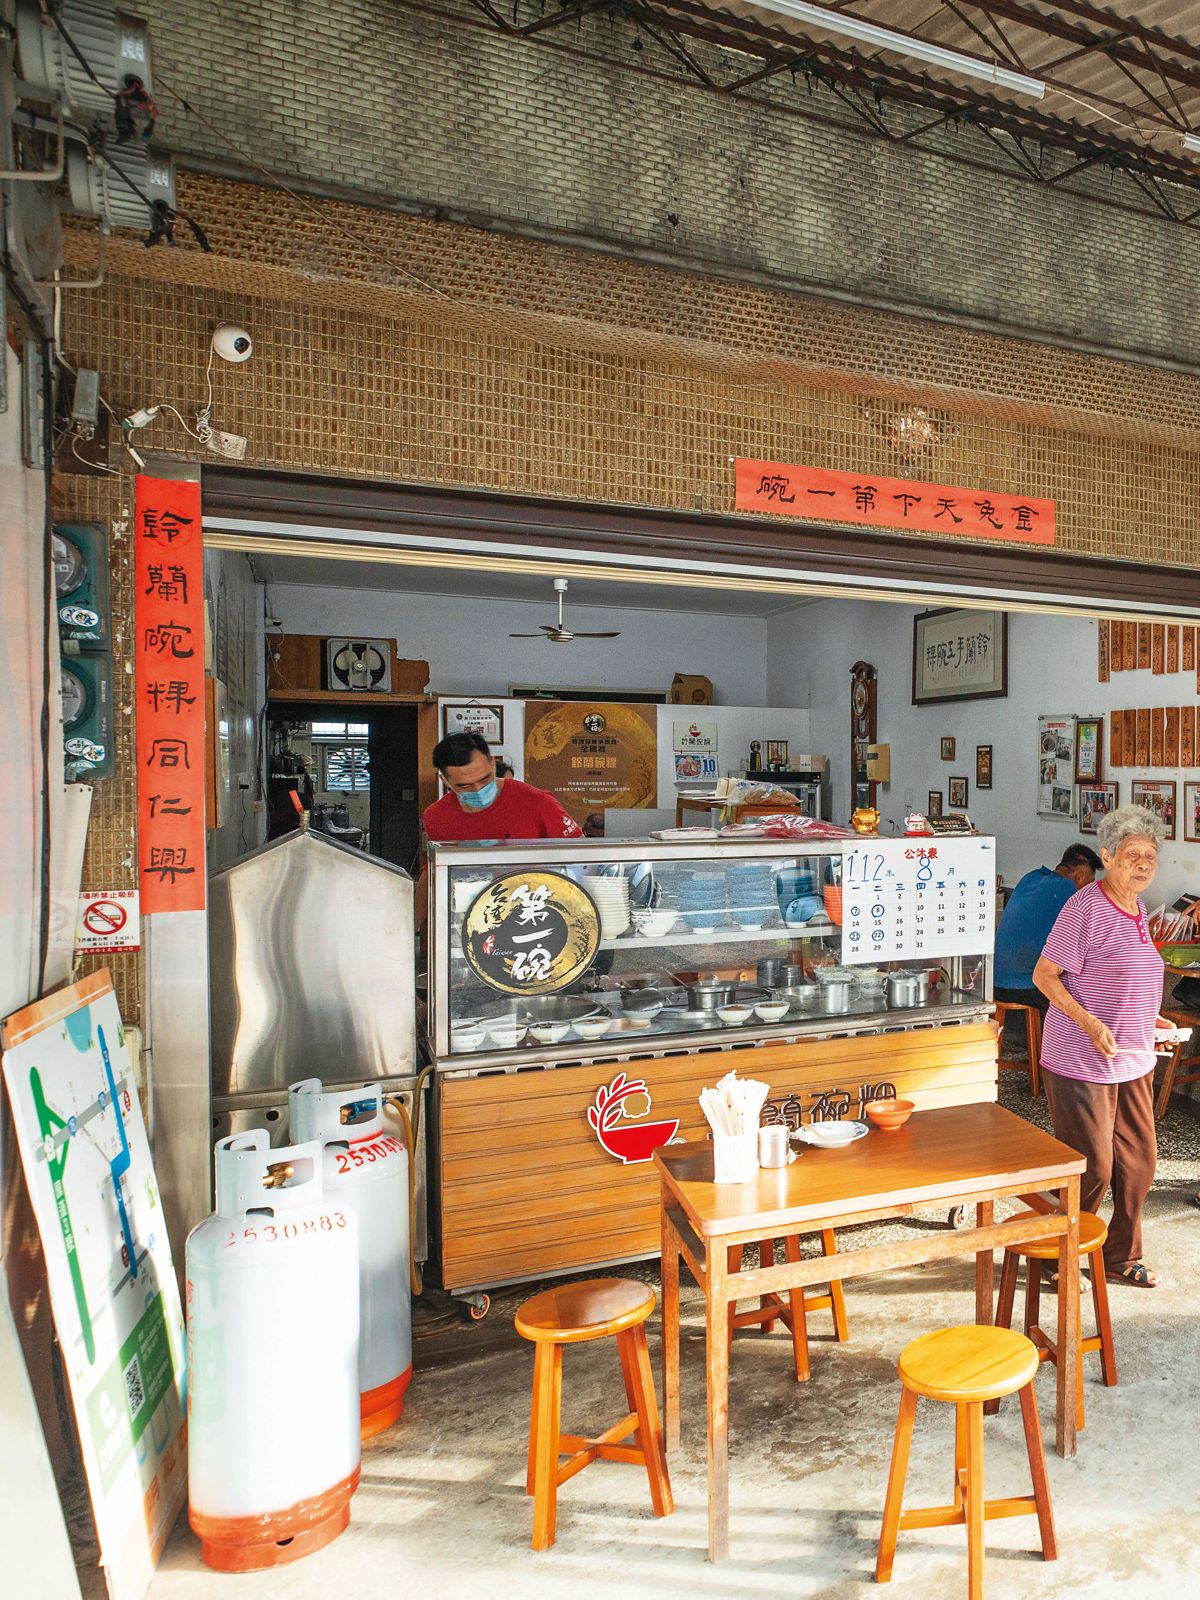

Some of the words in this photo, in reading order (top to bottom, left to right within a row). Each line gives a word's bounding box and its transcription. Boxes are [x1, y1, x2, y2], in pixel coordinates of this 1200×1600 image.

[904, 848, 939, 859] 公休表
[847, 854, 885, 882] 112
[917, 857, 932, 881] 8
[510, 884, 556, 982] 第一碗
